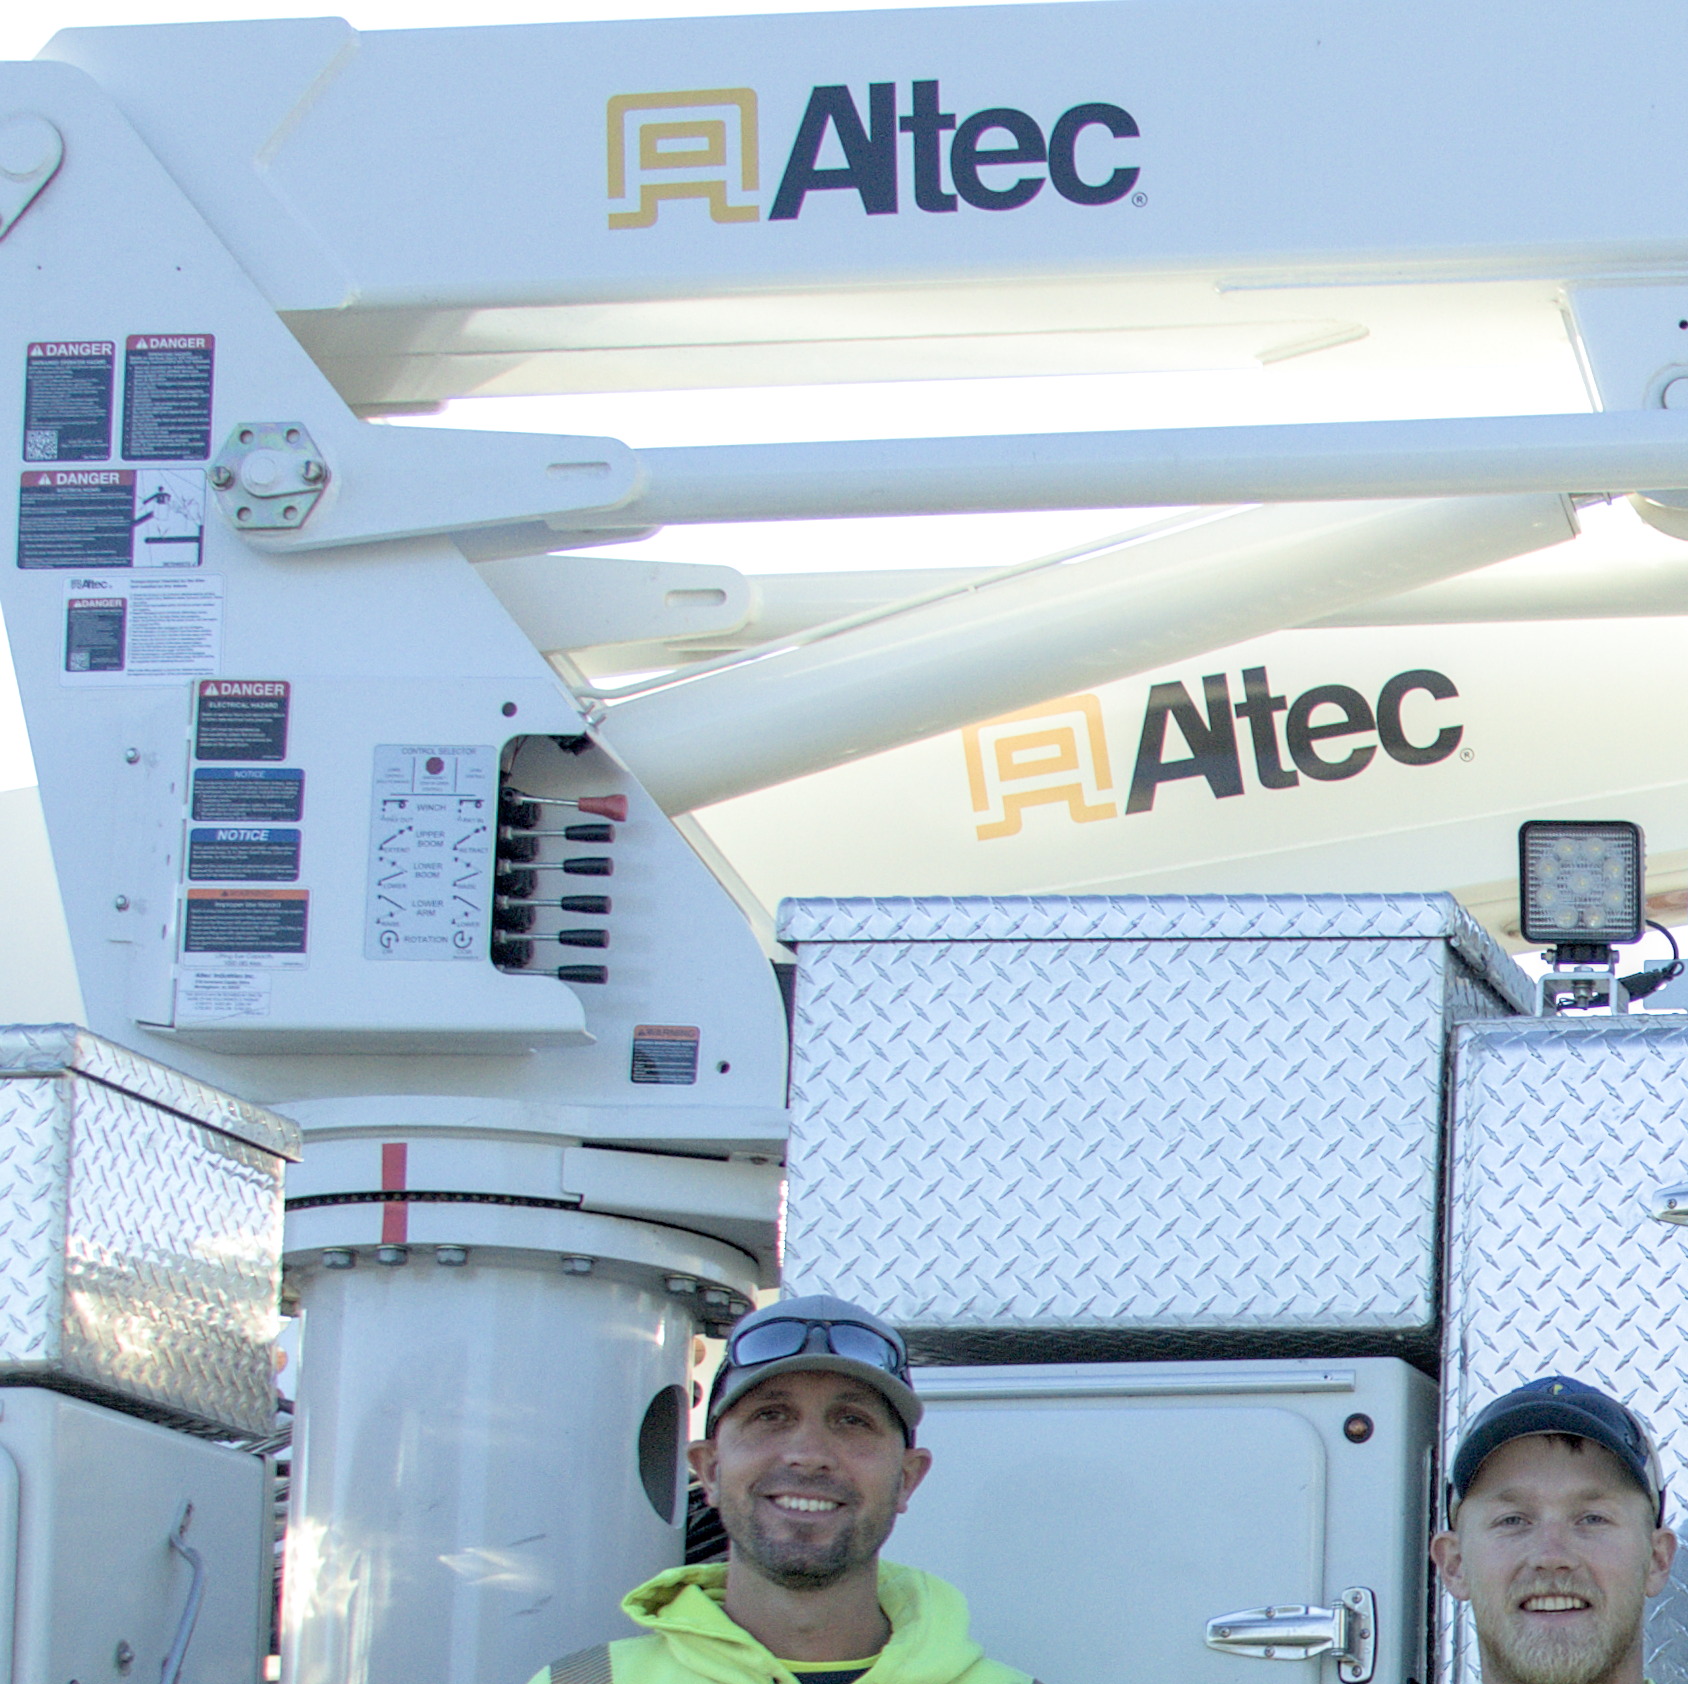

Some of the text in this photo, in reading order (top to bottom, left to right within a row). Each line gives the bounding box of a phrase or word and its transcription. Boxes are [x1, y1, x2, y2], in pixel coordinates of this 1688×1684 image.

[768, 79, 1141, 221] Altec
[46, 343, 112, 356] DANGER
[150, 338, 205, 349] DANGER
[56, 472, 120, 485] DANGER
[81, 599, 122, 608] DANGER
[221, 683, 284, 696] DANGER
[1125, 666, 1464, 816] Altec
[401, 747, 436, 755] CONTROL
[234, 770, 266, 778] NOTICE
[217, 829, 270, 841] NOTICE
